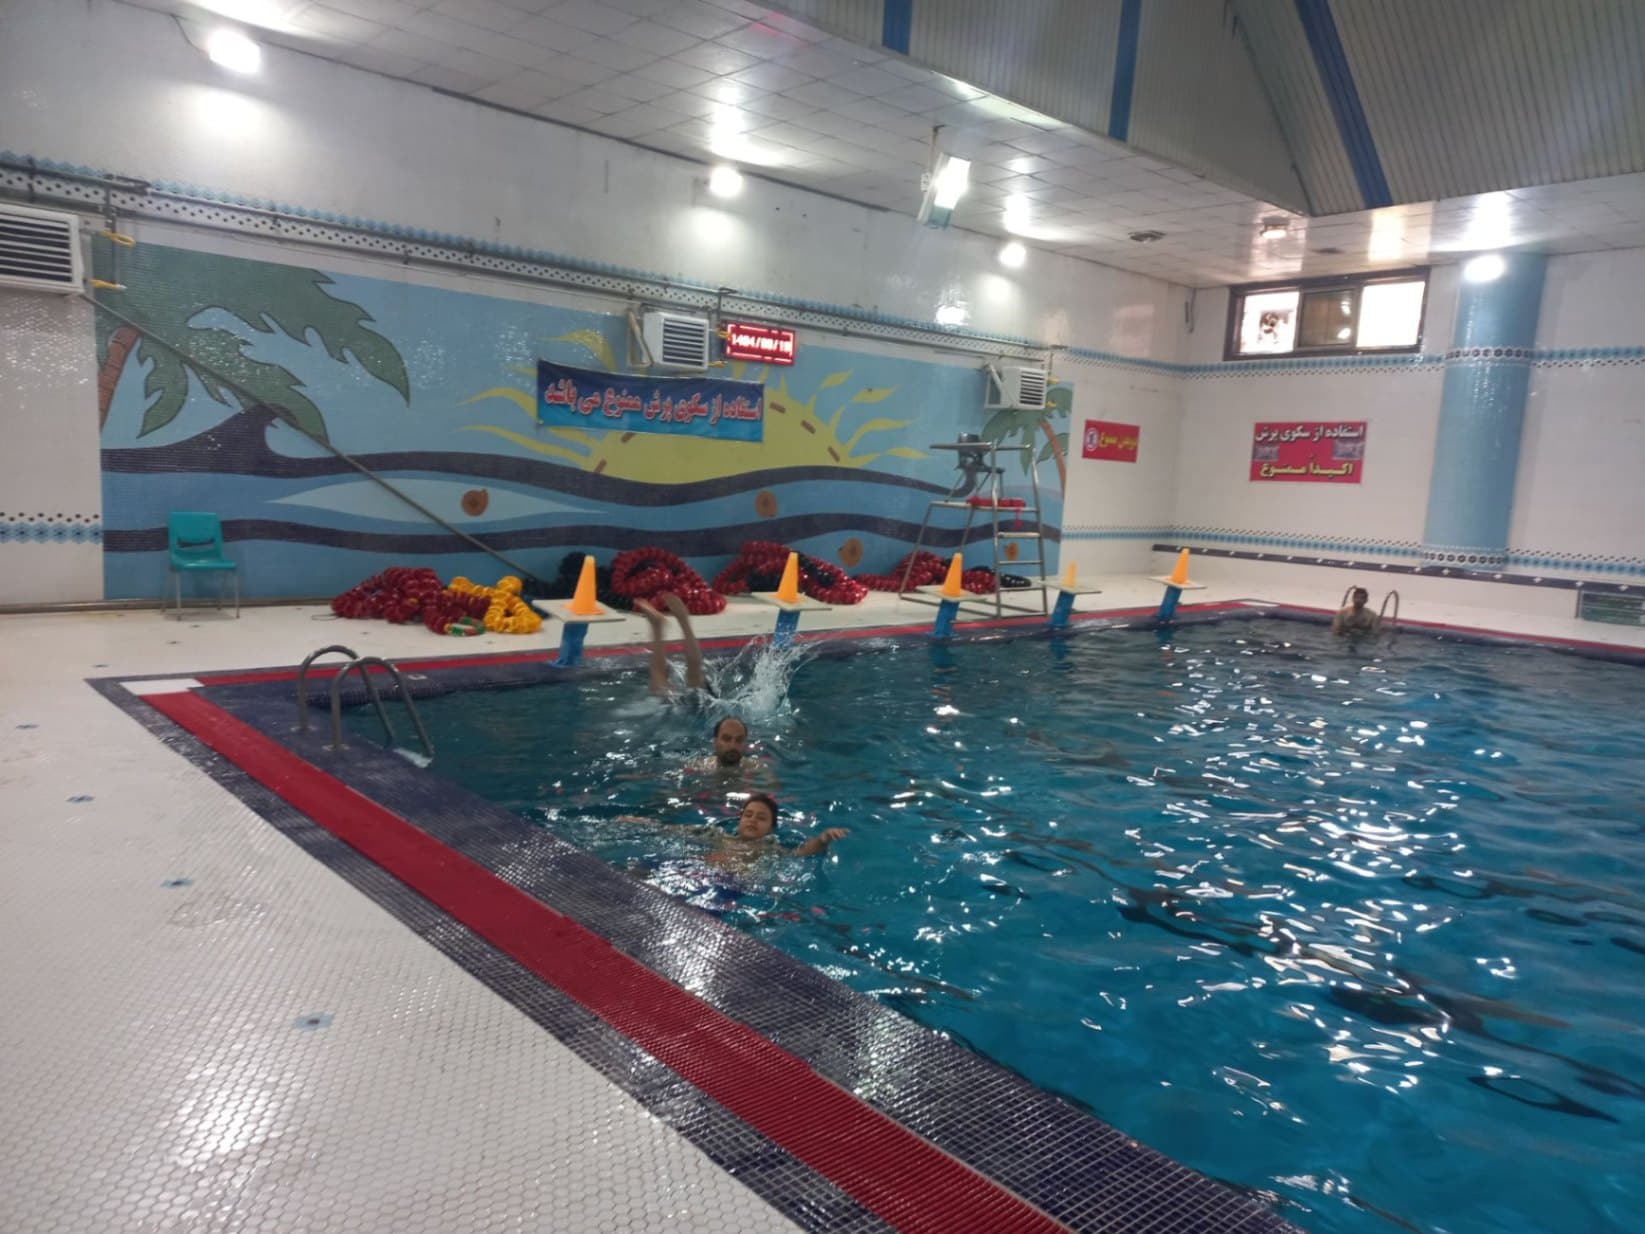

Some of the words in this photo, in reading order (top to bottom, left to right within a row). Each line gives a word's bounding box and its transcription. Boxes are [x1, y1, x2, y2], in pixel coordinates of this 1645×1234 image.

[544, 378, 577, 414] باشد
[578, 391, 601, 415] می
[602, 387, 642, 417] ممنوع
[643, 388, 673, 422] پرش
[673, 392, 709, 423] سکوی
[722, 395, 763, 421] استفاده
[709, 393, 722, 425] از
[1255, 426, 1279, 441] پرش
[1280, 425, 1311, 442] سکوی
[1312, 425, 1324, 442] از
[1324, 424, 1364, 438] استفاده
[1260, 462, 1307, 477] ممنوع
